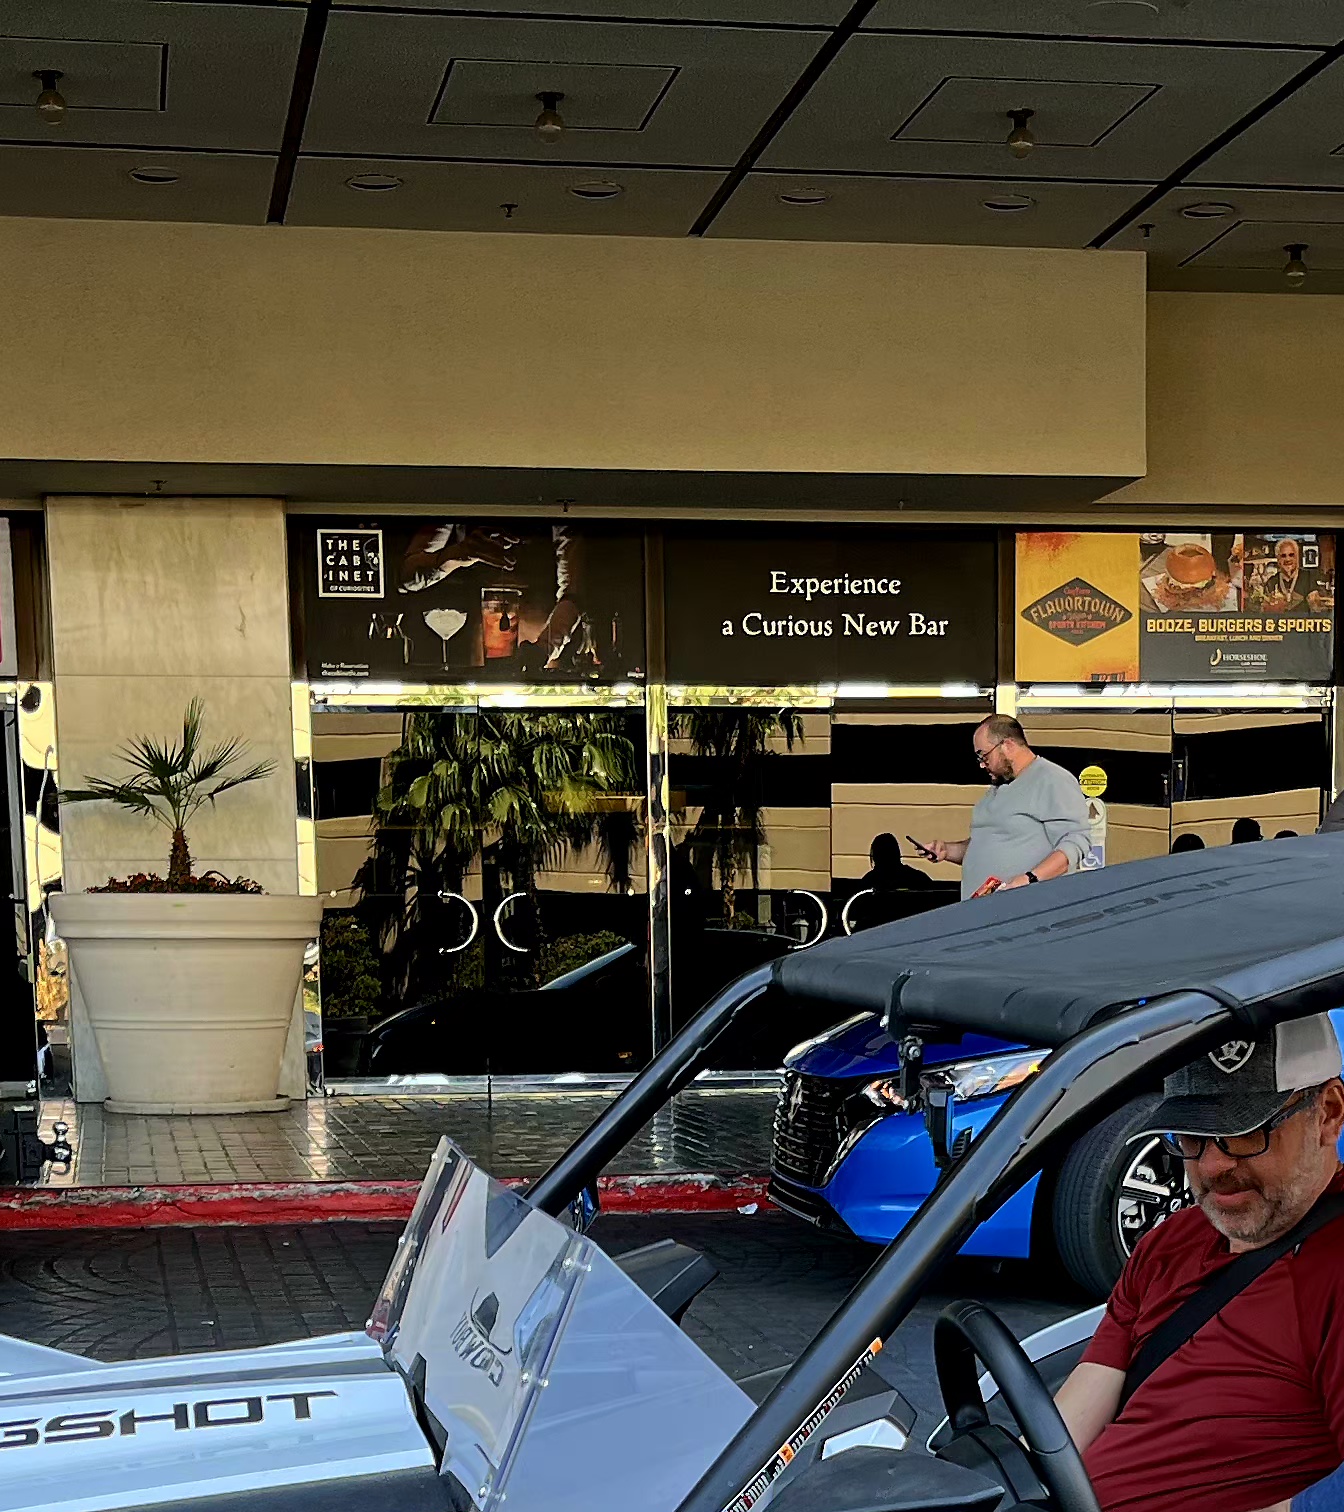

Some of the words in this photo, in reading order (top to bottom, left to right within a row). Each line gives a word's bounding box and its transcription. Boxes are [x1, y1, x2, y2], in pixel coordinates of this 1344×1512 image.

[326, 540, 360, 550] THE
[326, 555, 360, 566] CAB
[328, 570, 374, 581] INET
[769, 571, 901, 601] Experience
[722, 620, 733, 635] a
[742, 612, 833, 636] Curious
[841, 613, 900, 636] New
[908, 613, 949, 635] Bar
[1146, 618, 1196, 635] BOOZE,
[1198, 619, 1263, 633] BURGERS
[1265, 619, 1276, 633] &
[1278, 619, 1332, 633] SPORTS
